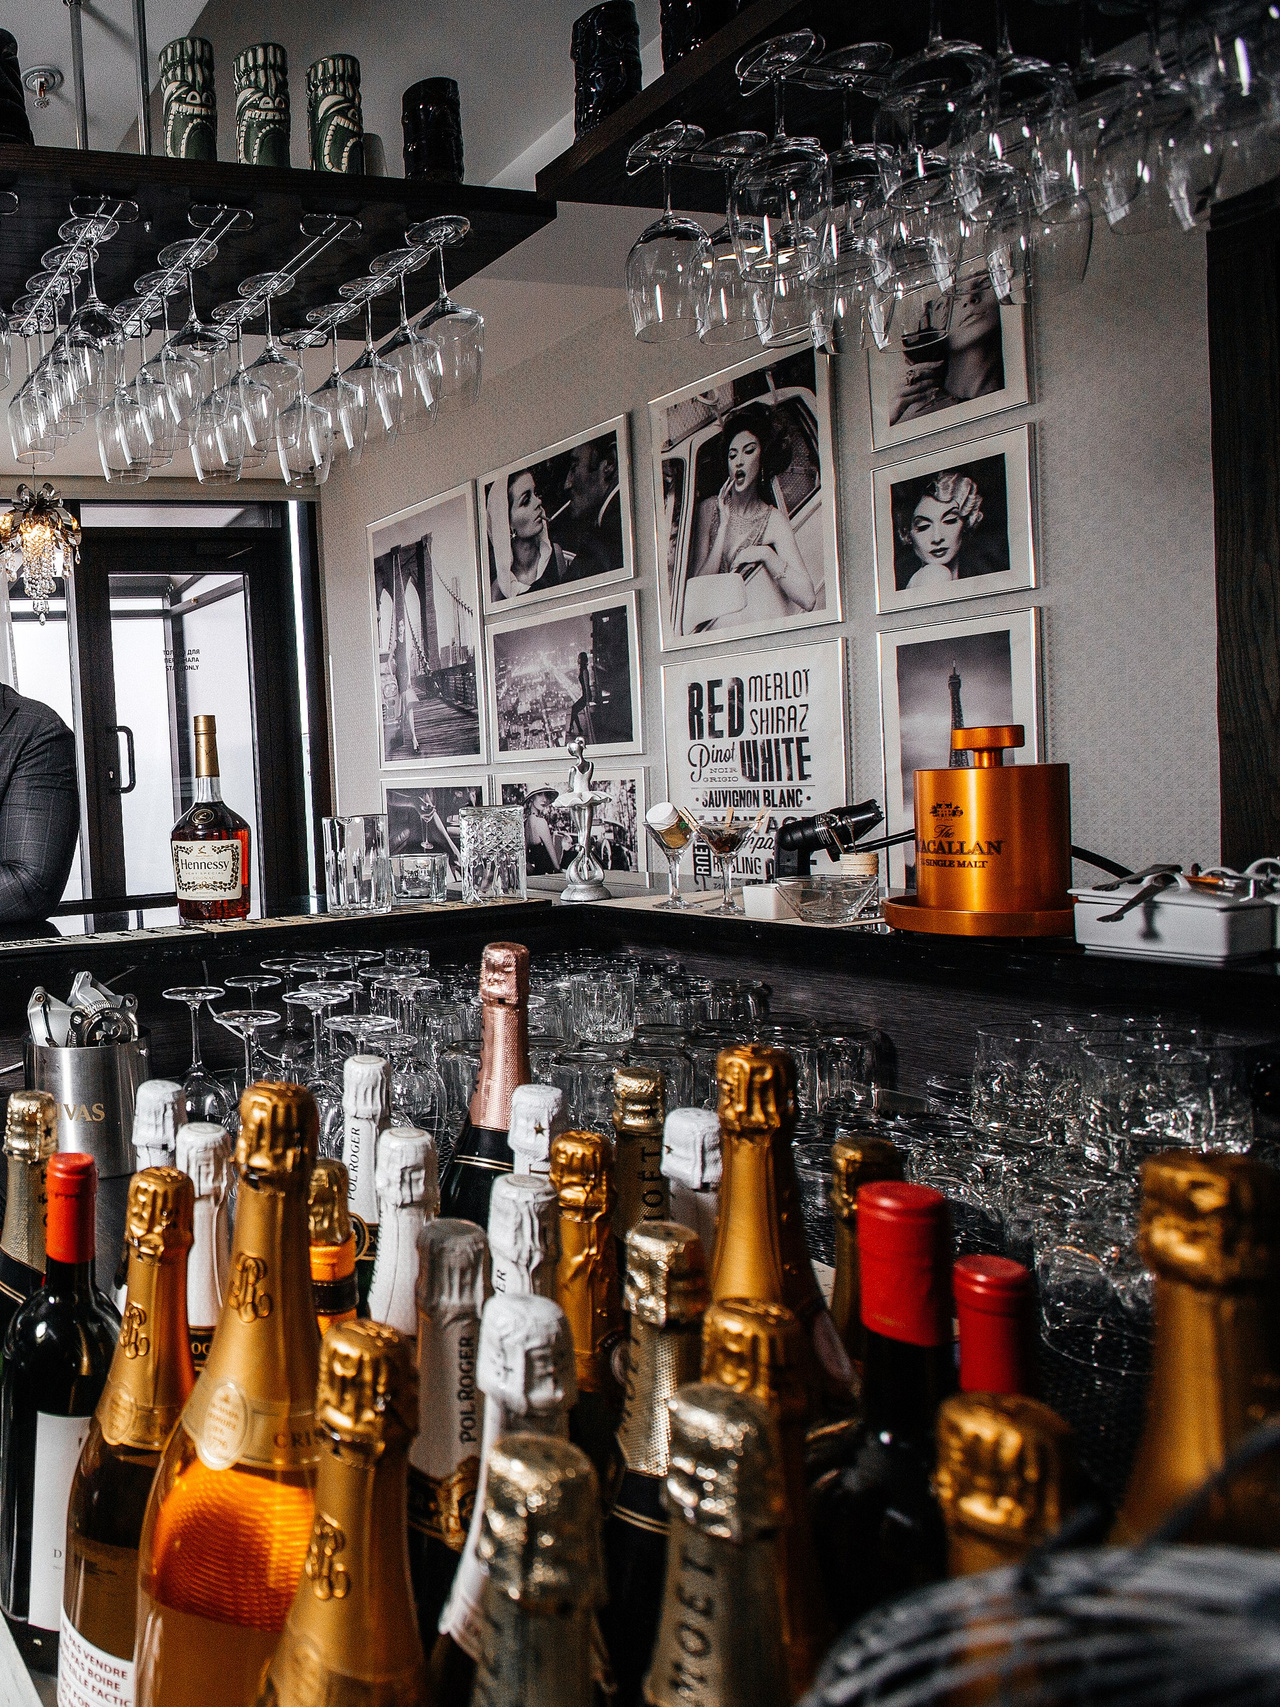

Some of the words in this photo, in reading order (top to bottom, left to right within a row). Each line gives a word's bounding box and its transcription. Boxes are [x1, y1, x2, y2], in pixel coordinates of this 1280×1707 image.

[688, 677, 744, 740] RED
[748, 669, 810, 702] MERLOT
[749, 704, 809, 735] SHIRAZ
[688, 741, 736, 782] Pinot
[739, 736, 812, 782] WHITE
[702, 789, 760, 808] SAUVIGNON
[763, 789, 803, 807] BLANC
[933, 825, 955, 838] The
[917, 840, 1004, 855] ACALLAN
[181, 859, 230, 871] Hennessy
[713, 856, 761, 874] RSLING
[926, 859, 955, 867] SINGLE
[56, 1103, 106, 1122] IVAS
[349, 1127, 360, 1172] ROGER
[457, 1337, 475, 1401] ROGER
[460, 1402, 477, 1444] POL
[84, 1650, 128, 1680] VENDRE
[88, 1668, 120, 1692] BOIRE
[92, 1685, 132, 1707] FACTIC
